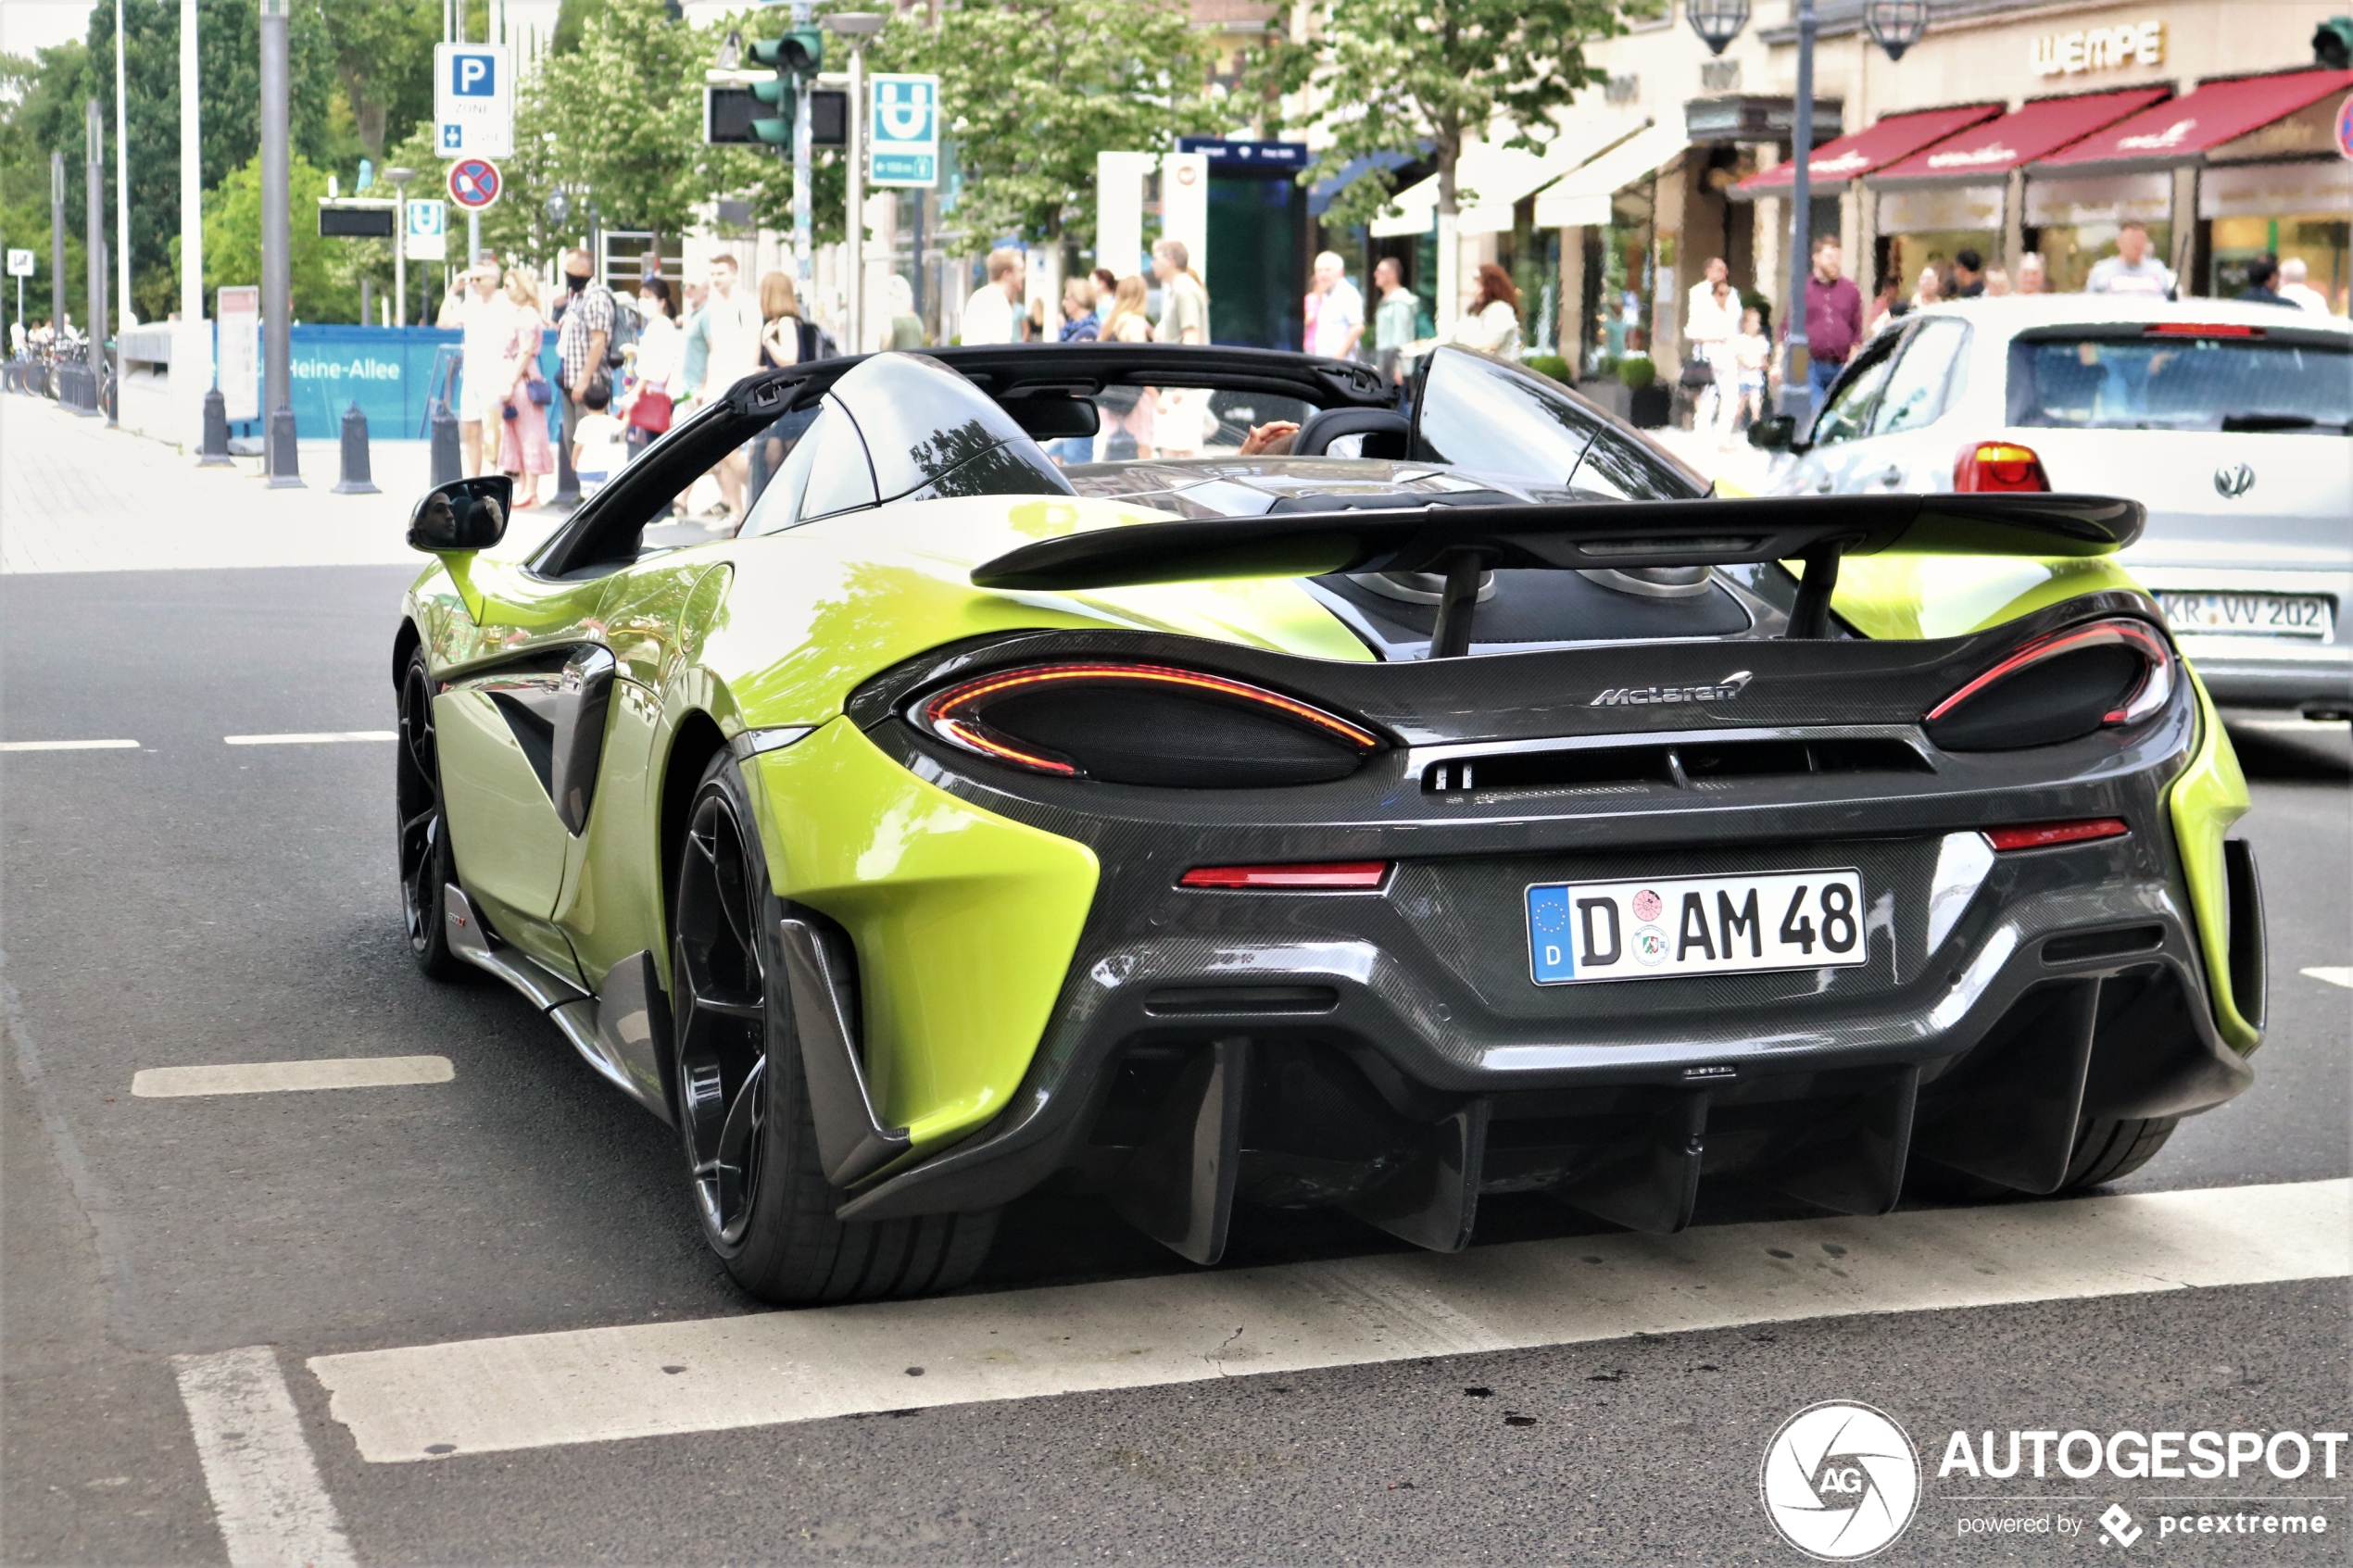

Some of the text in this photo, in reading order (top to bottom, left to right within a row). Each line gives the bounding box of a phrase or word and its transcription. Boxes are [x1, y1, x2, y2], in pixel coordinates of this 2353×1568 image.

[2031, 20, 2168, 79] WEMPE
[461, 58, 485, 93] P
[881, 83, 926, 139] U
[2163, 596, 2320, 628] KR VV 202
[1590, 685, 1737, 707] McLaren
[1576, 897, 1622, 968] D
[1676, 887, 1763, 962] AM
[1779, 882, 1857, 955] 48
[1545, 946, 1561, 966] D
